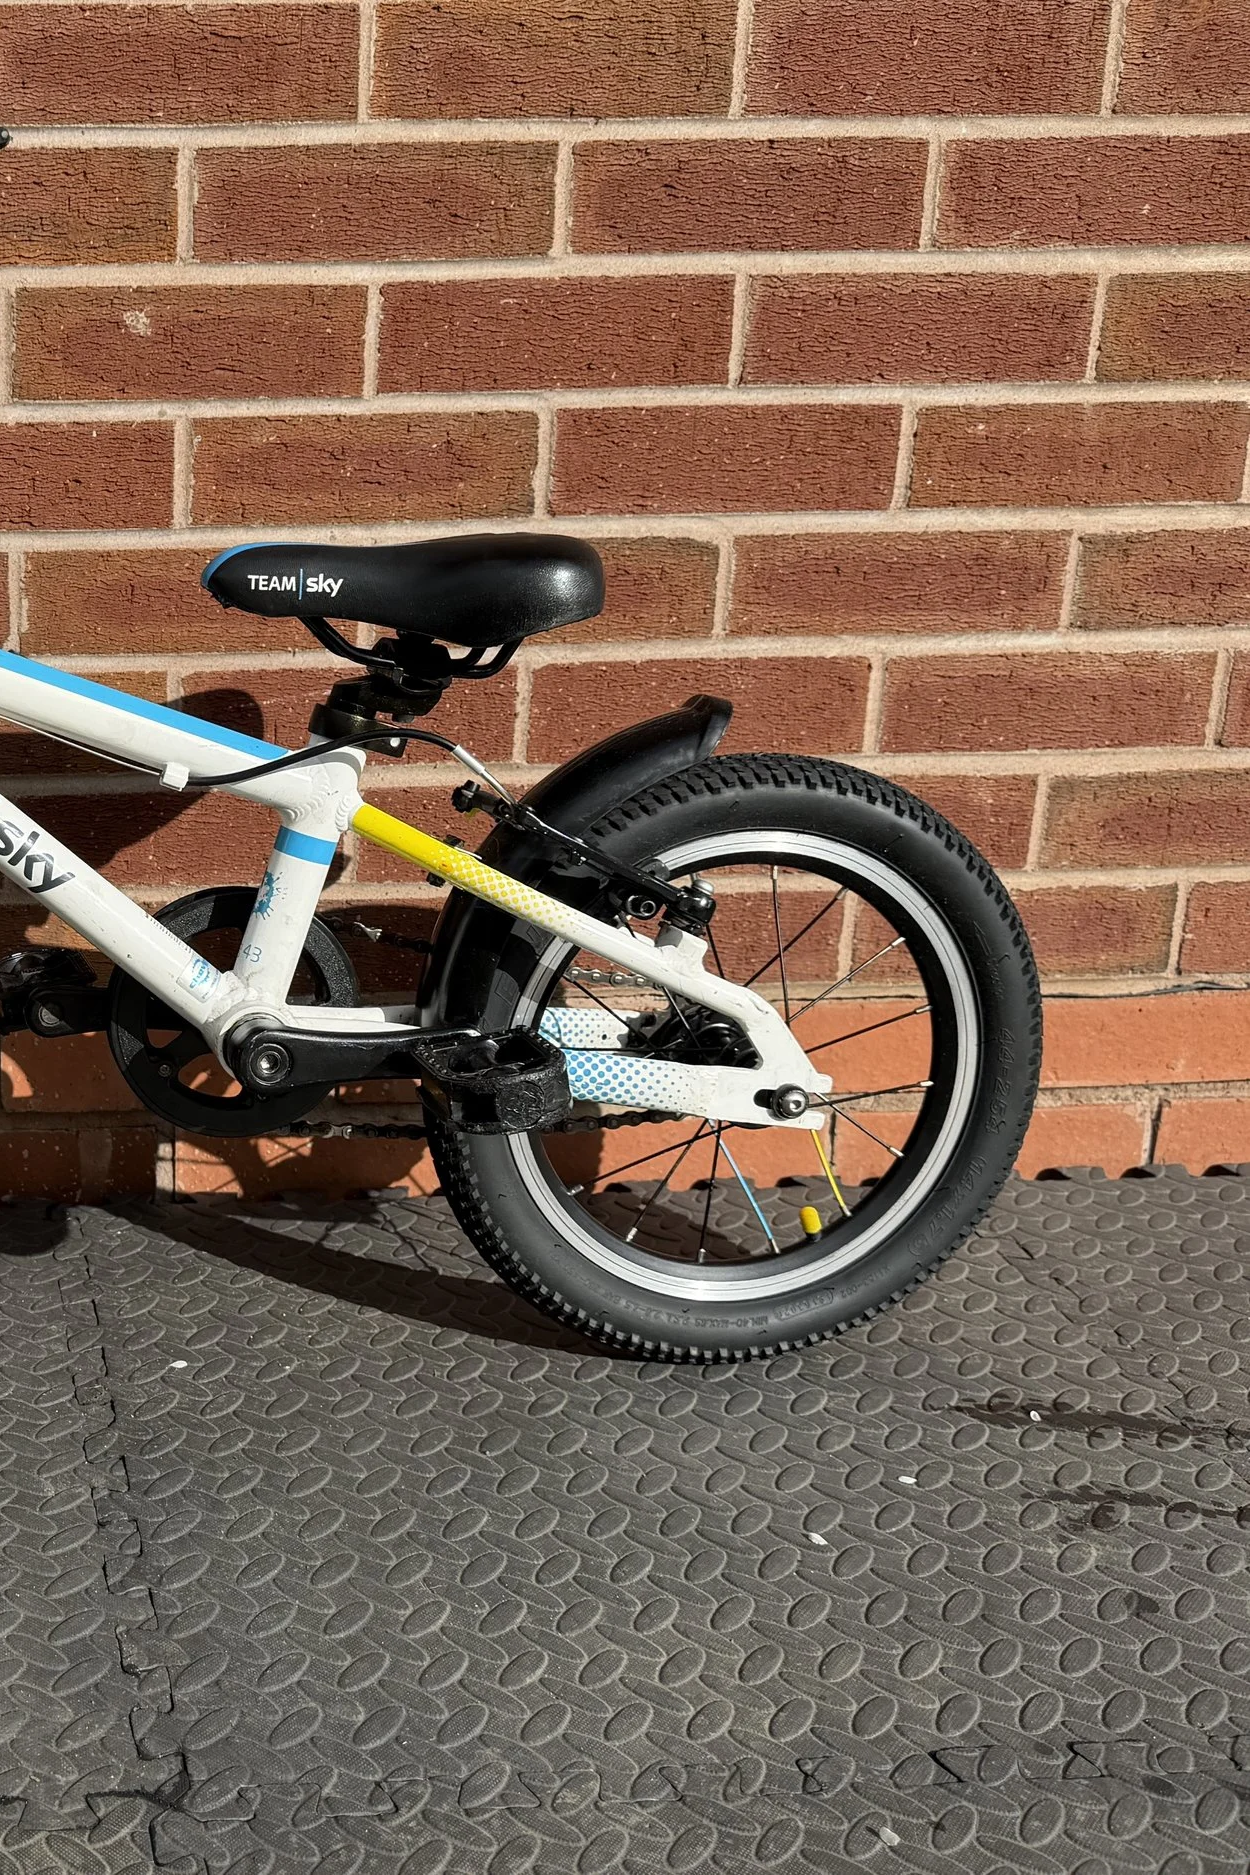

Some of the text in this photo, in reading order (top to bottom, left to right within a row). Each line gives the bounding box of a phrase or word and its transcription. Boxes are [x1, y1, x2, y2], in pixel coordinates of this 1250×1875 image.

[247, 573, 343, 597] TEAM sky
[243, 944, 262, 963] 43
[985, 1026, 1013, 1135] 44-254
